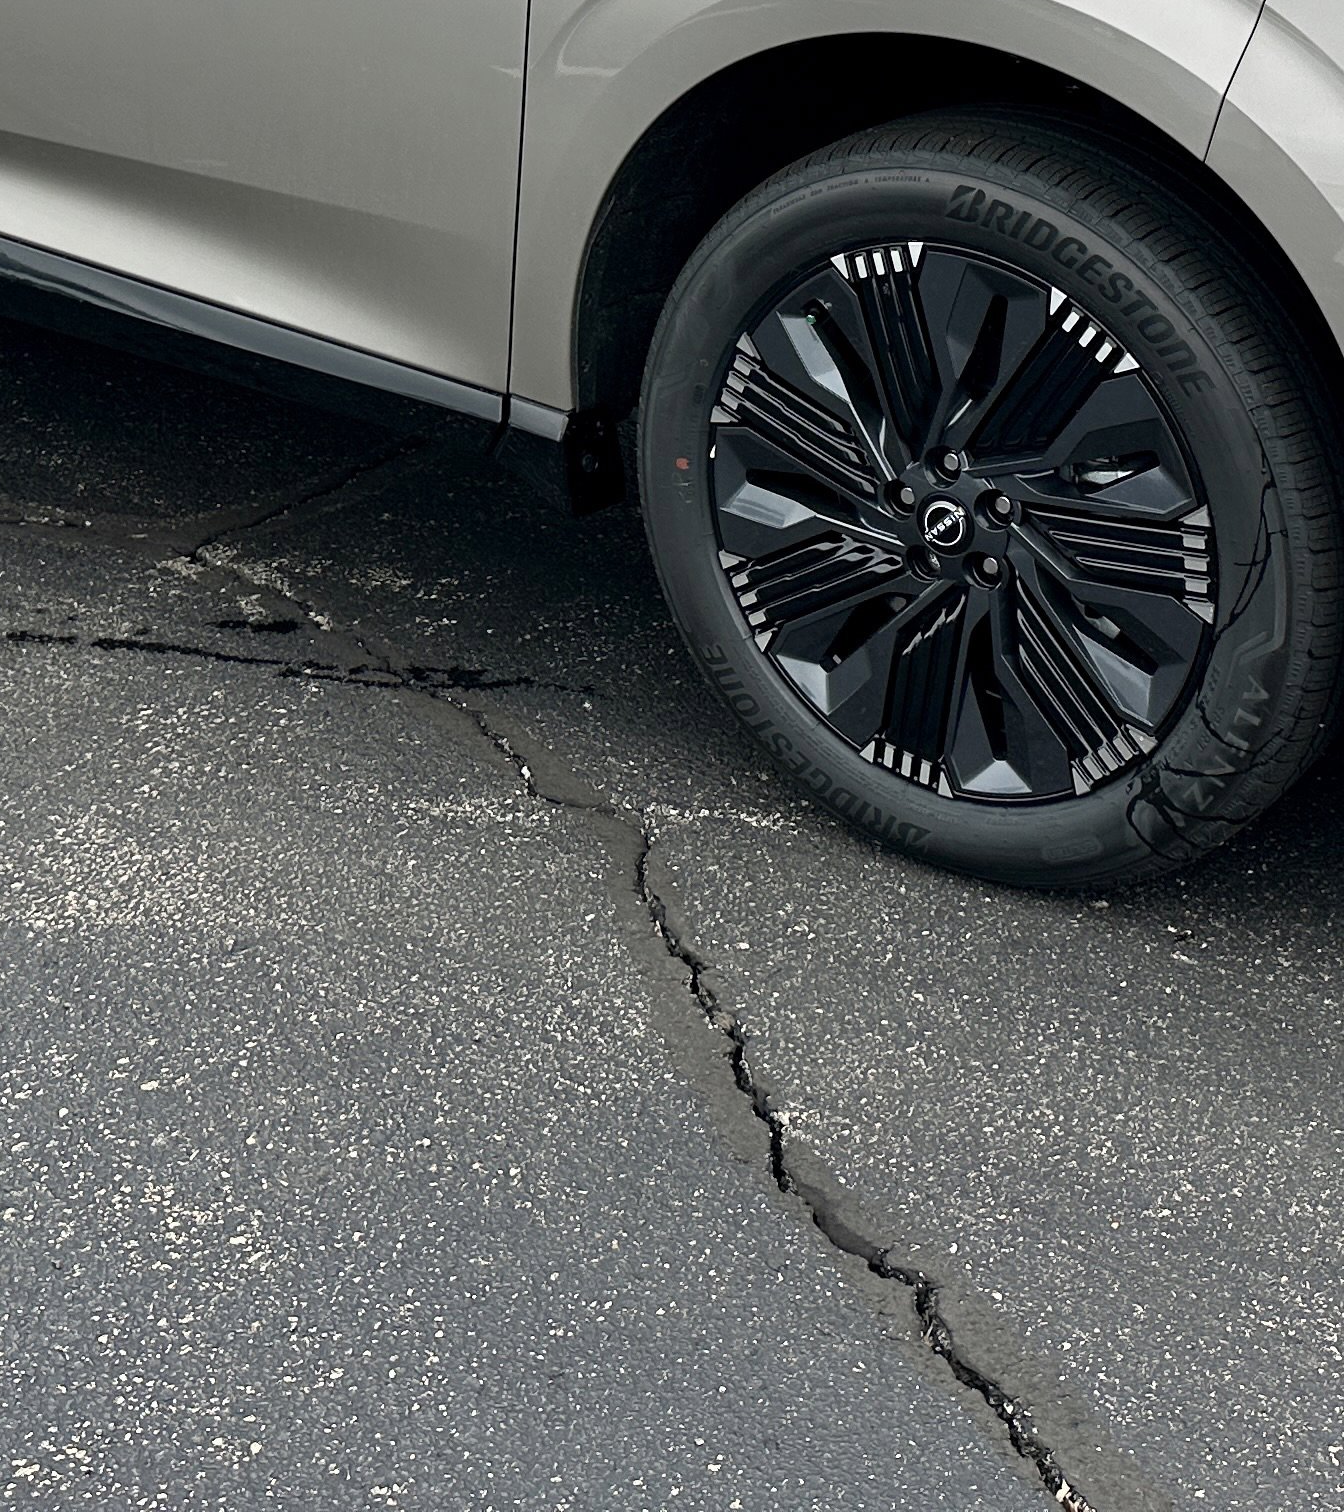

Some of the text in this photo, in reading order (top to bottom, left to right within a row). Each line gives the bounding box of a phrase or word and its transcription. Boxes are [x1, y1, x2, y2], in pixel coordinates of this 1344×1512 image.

[944, 184, 1216, 398] BRIDGESTONE
[924, 506, 966, 542] NISSAN
[699, 642, 931, 854] BRIDGESTONE
